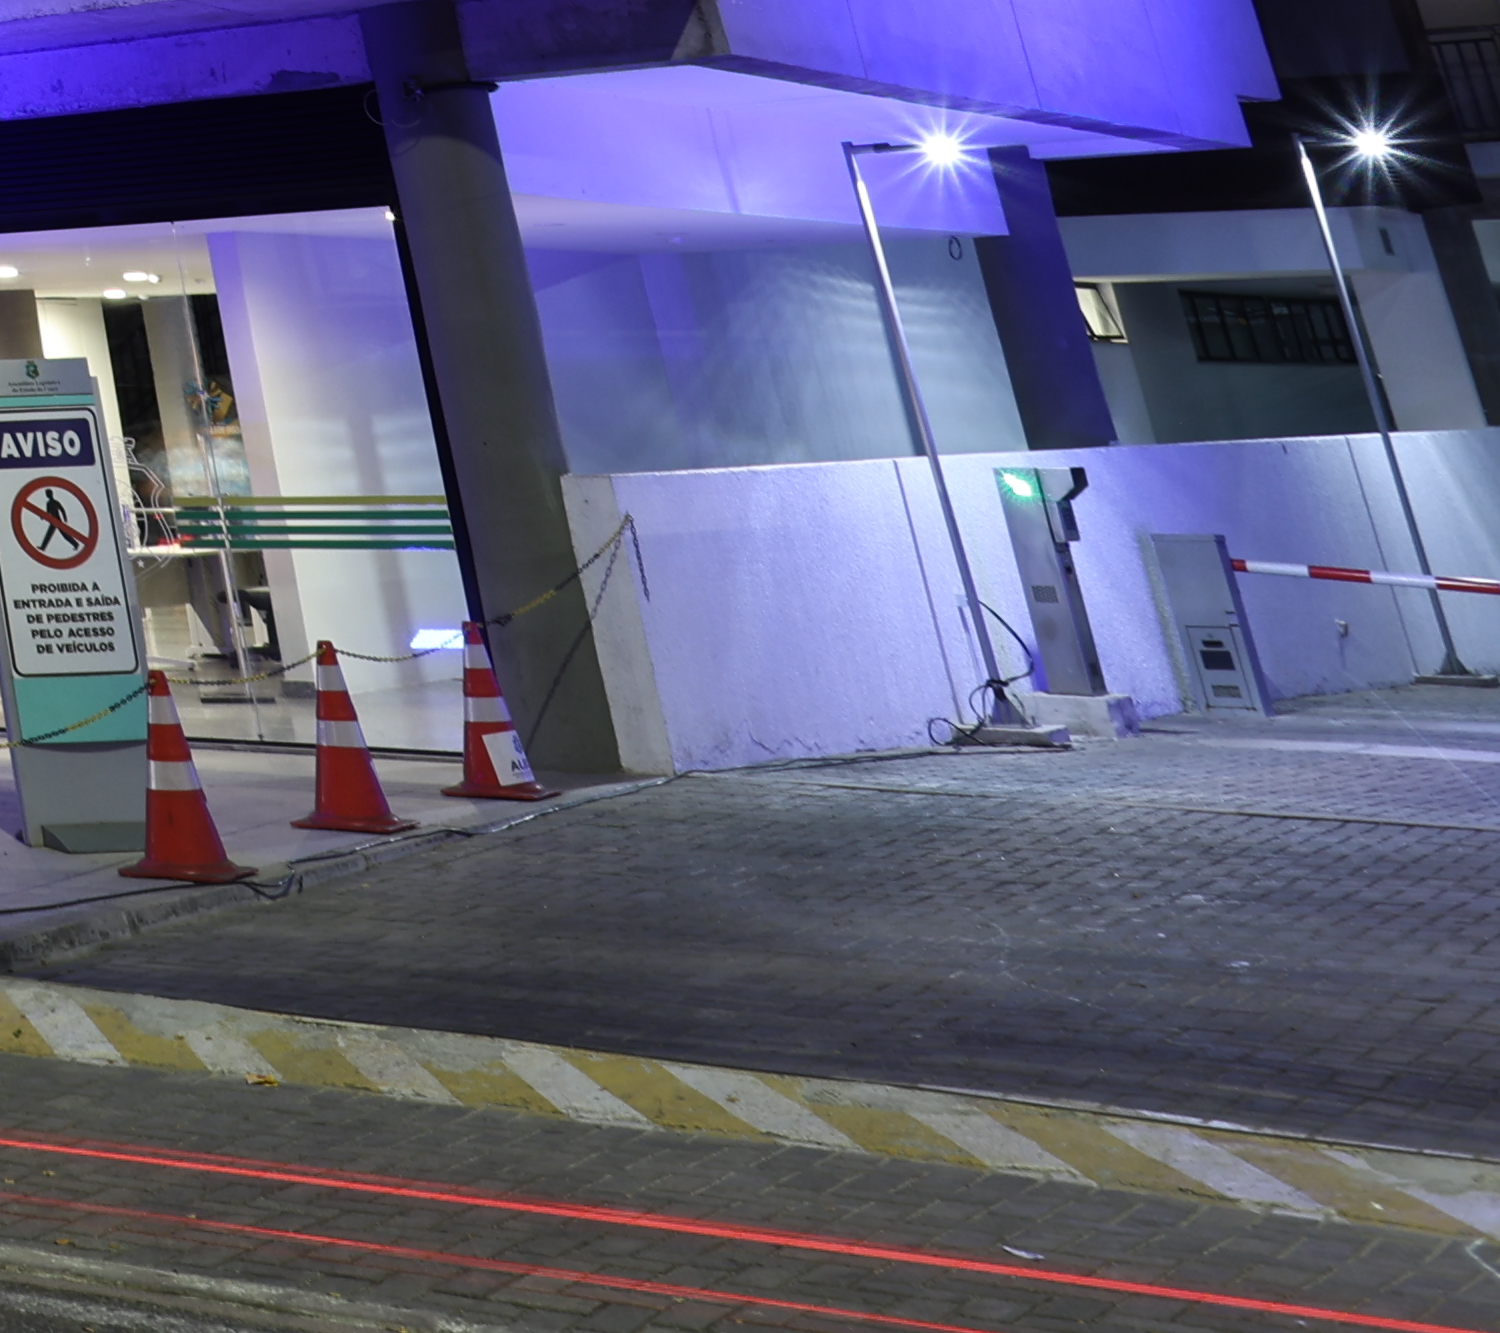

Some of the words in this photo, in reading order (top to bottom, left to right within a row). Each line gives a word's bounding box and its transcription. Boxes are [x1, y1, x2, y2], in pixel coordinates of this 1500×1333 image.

[1, 430, 81, 458] AVISO
[31, 582, 88, 593] PROIBIDA
[92, 582, 100, 592] A
[13, 598, 73, 609] ENTRADA
[75, 597, 83, 608] E
[86, 594, 121, 606] SAÍDA
[26, 614, 43, 624] DE
[47, 611, 115, 623] PEDESTRES
[31, 629, 63, 639] PELO
[68, 627, 115, 638] ACESSO
[36, 644, 53, 654] DE
[56, 640, 116, 653] VEÍCULOS
